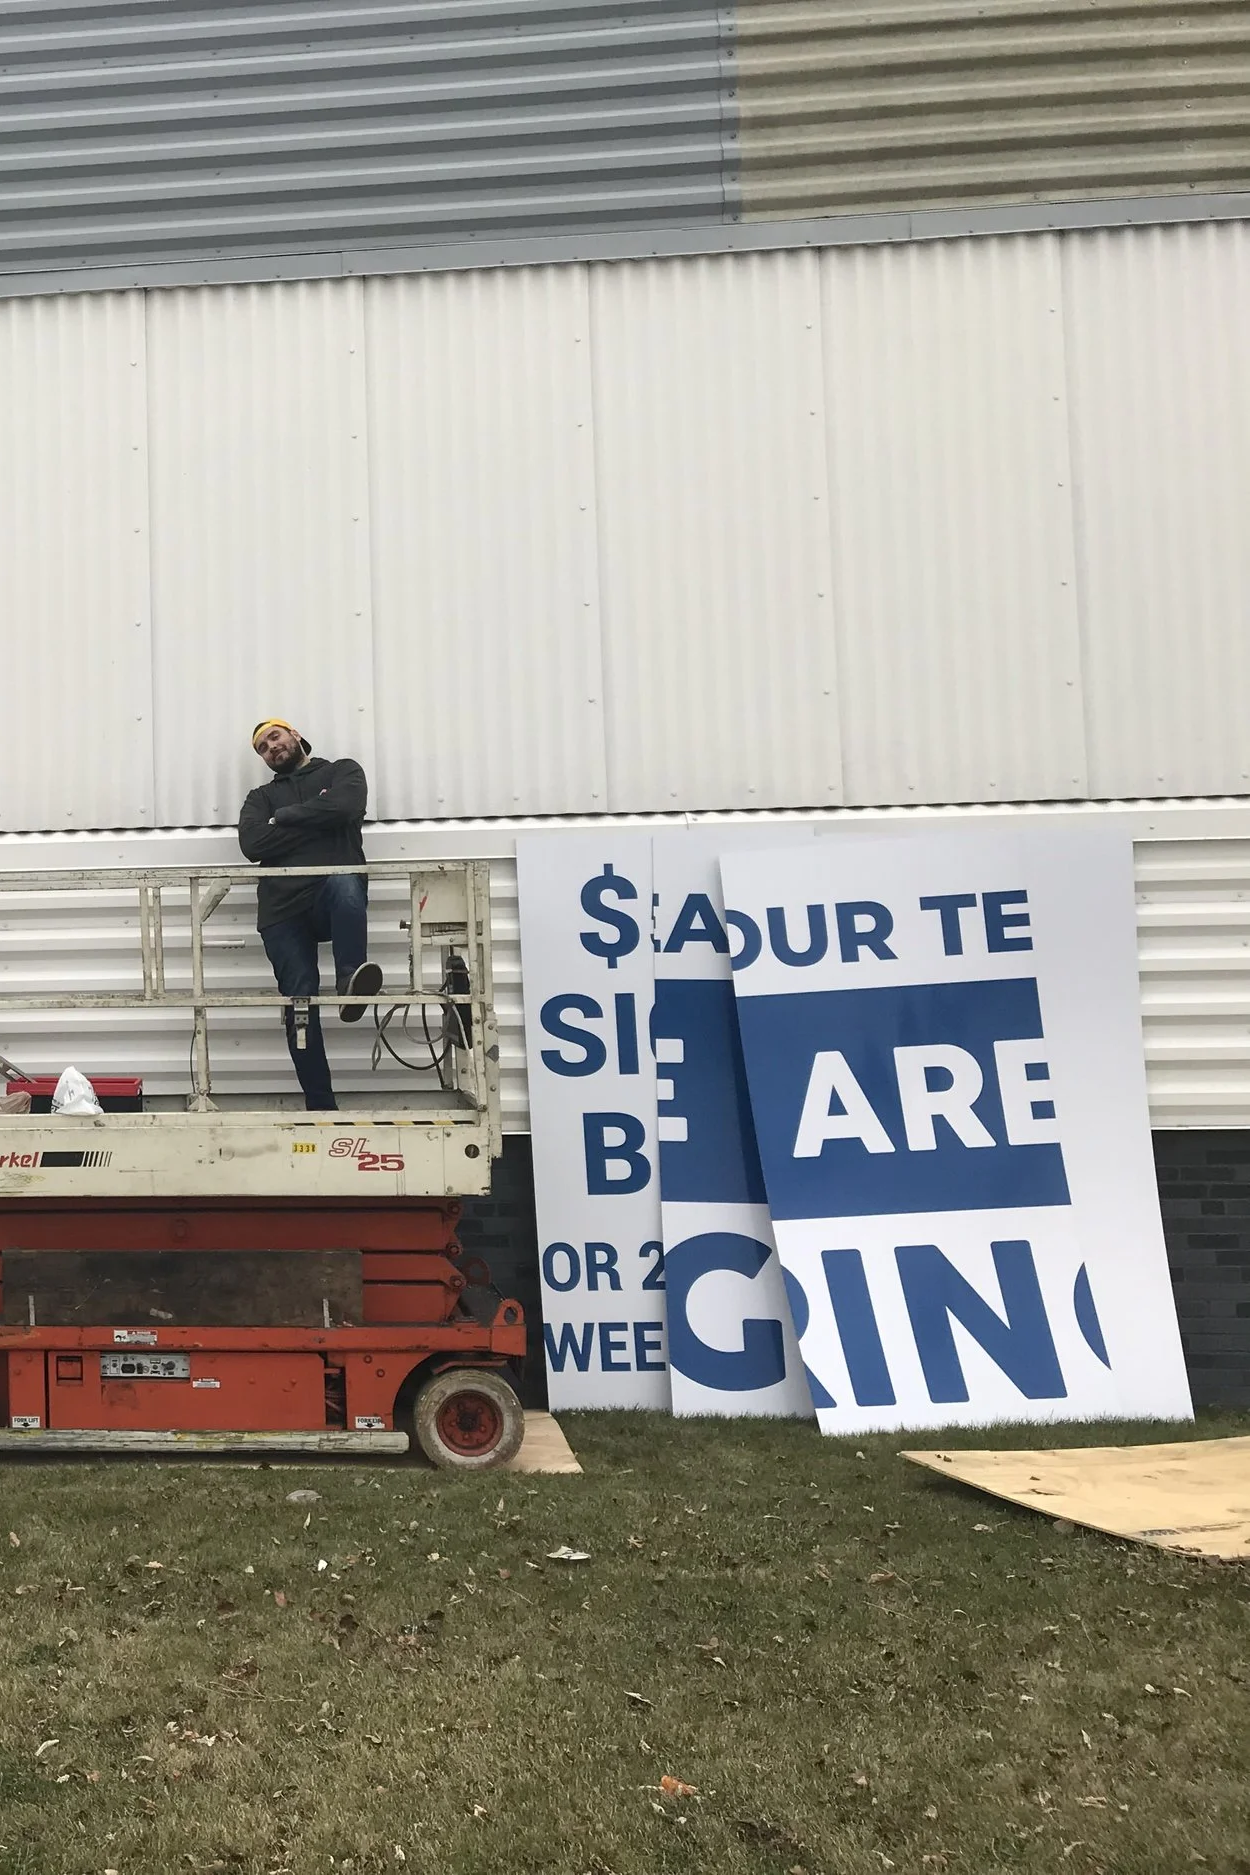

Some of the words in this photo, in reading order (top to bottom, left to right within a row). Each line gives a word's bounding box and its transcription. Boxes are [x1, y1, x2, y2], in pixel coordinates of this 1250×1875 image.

[919, 889, 1034, 957] TE
[540, 993, 656, 1078] SI
[793, 1038, 1061, 1159] ARE
[328, 1138, 372, 1158] SL
[357, 1153, 405, 1172] 25
[582, 1112, 652, 1196] B
[542, 1242, 623, 1292] OR
[663, 1232, 786, 1392] G
[543, 1321, 666, 1373] WEE
